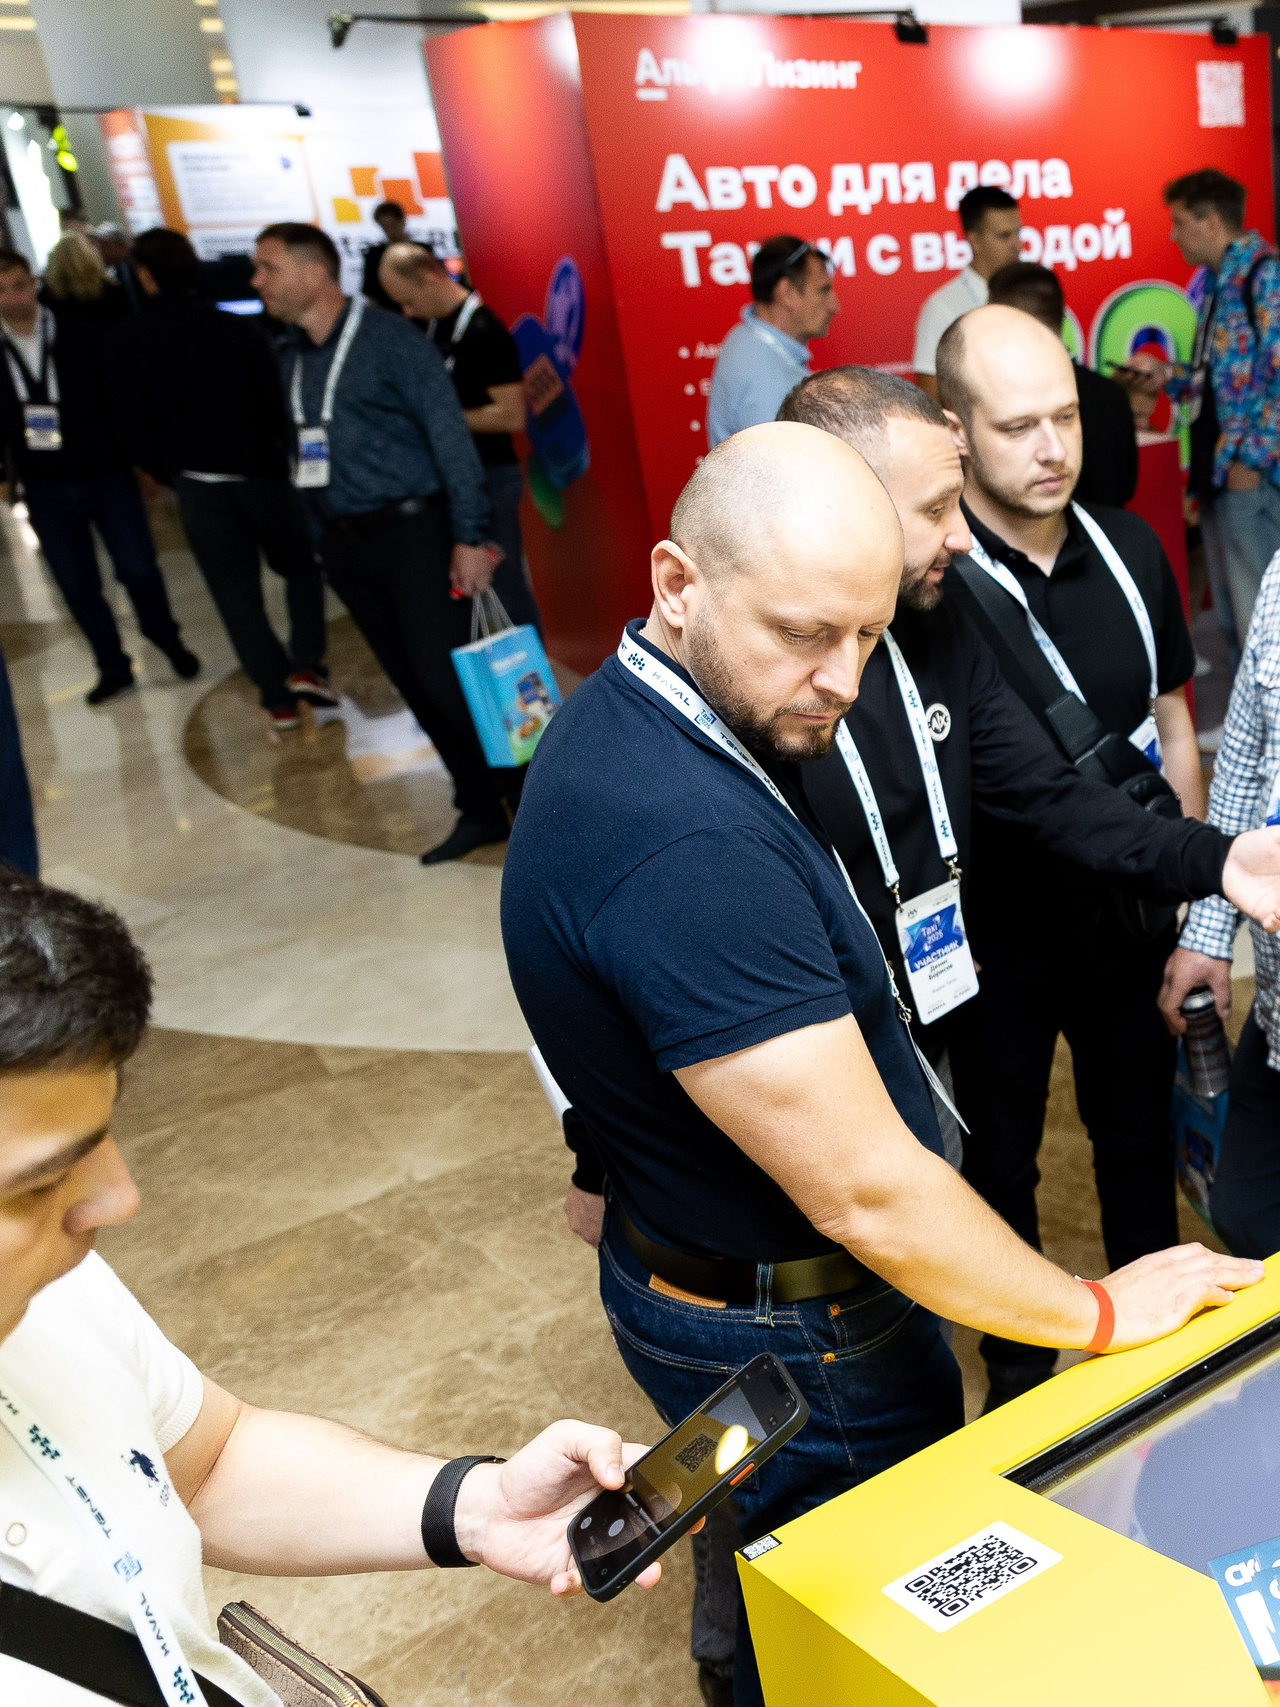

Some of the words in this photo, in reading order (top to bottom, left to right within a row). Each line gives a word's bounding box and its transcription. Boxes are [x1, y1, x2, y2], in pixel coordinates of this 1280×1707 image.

[656, 153, 817, 213] Авто
[828, 162, 936, 216] для
[945, 158, 1073, 211] дела
[660, 229, 857, 288] Таи
[866, 233, 902, 276] с
[910, 208, 1133, 276] выодой
[652, 671, 691, 706] HAVAL
[698, 717, 711, 729] 2025
[700, 709, 713, 723] Taxi
[720, 731, 757, 768] TENET
[921, 923, 938, 937] Taxi
[912, 940, 960, 970] УЧАСТНИК
[65, 1474, 112, 1540] TENET
[141, 1592, 170, 1657] HAVAL
